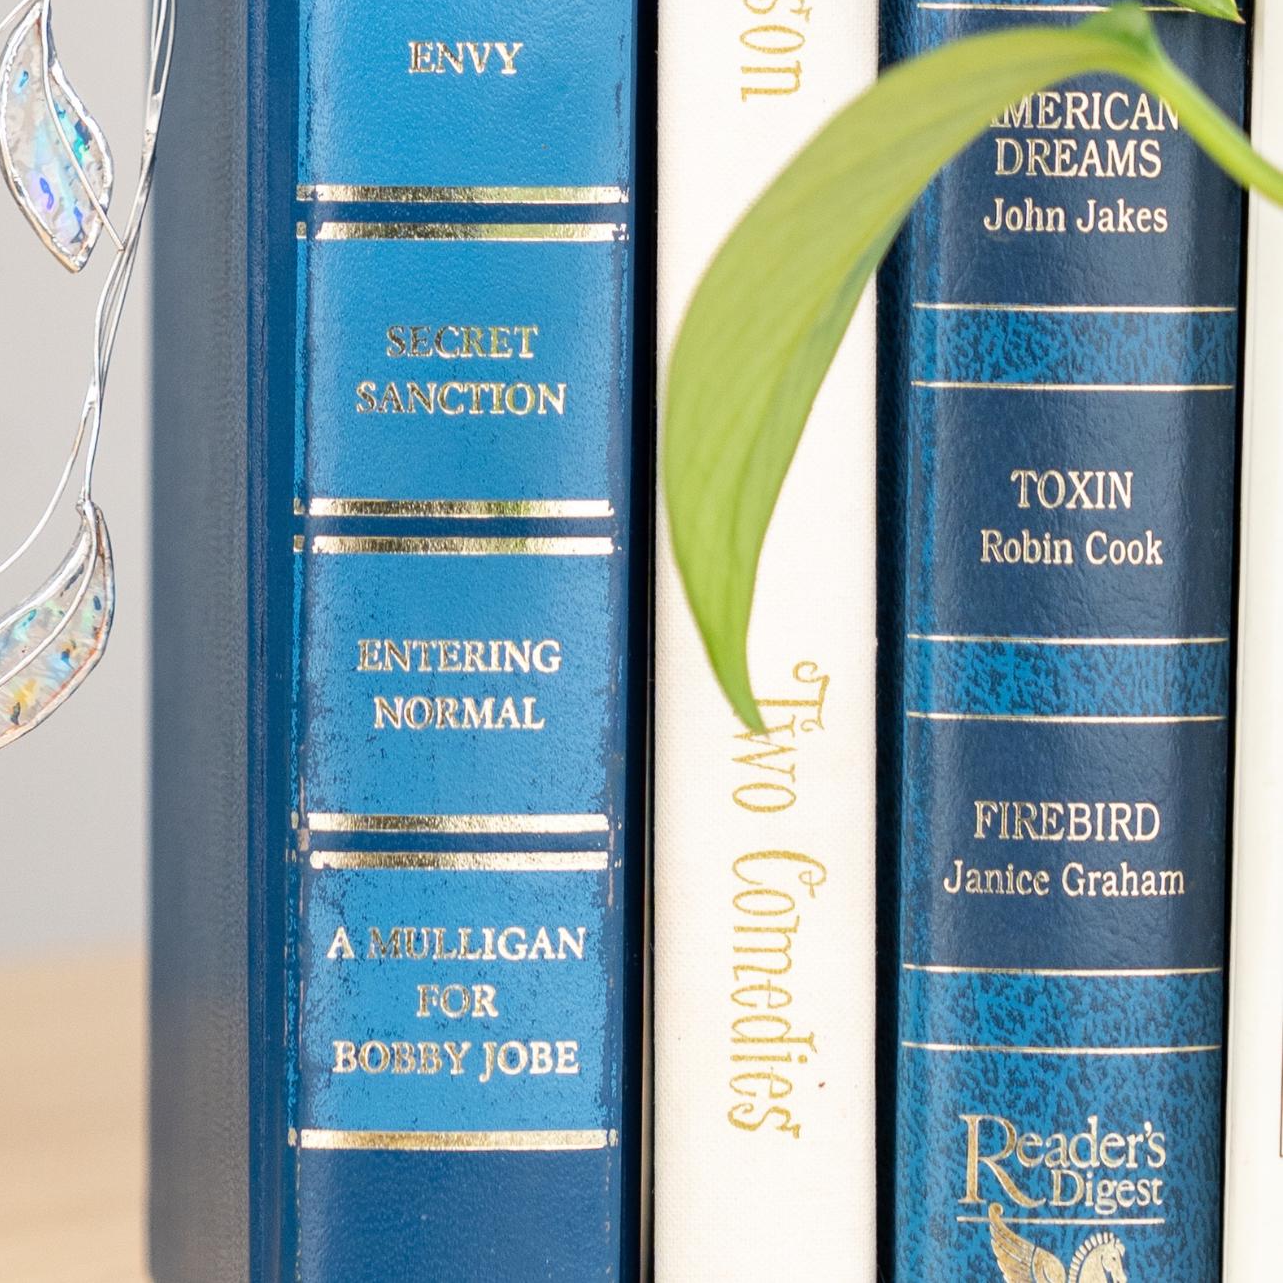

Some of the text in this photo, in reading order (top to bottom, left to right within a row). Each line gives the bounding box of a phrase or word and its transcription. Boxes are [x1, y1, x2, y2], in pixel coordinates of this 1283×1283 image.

[407, 41, 523, 74] ENVY
[989, 92, 1179, 131] MERICAN
[995, 138, 1161, 178] DREAMS
[983, 197, 1168, 233] John Jakes
[386, 325, 538, 359] SECRET
[356, 382, 566, 415] SANCTION
[1011, 470, 1134, 510] TOXIN
[980, 529, 1164, 566] Robin Cook
[356, 639, 562, 673] ENTERING
[373, 696, 546, 730] NORMAL
[973, 800, 1161, 842] FIREBIRD
[943, 860, 1186, 897] Janice Graham
[727, 660, 830, 1139] Two Comedies
[326, 926, 587, 961] A MULLIGAN
[415, 984, 499, 1019] FOR
[331, 1040, 580, 1083] BOBBY JOBE
[958, 1114, 1167, 1209] Reader's
[1052, 1169, 1164, 1215] Digest
